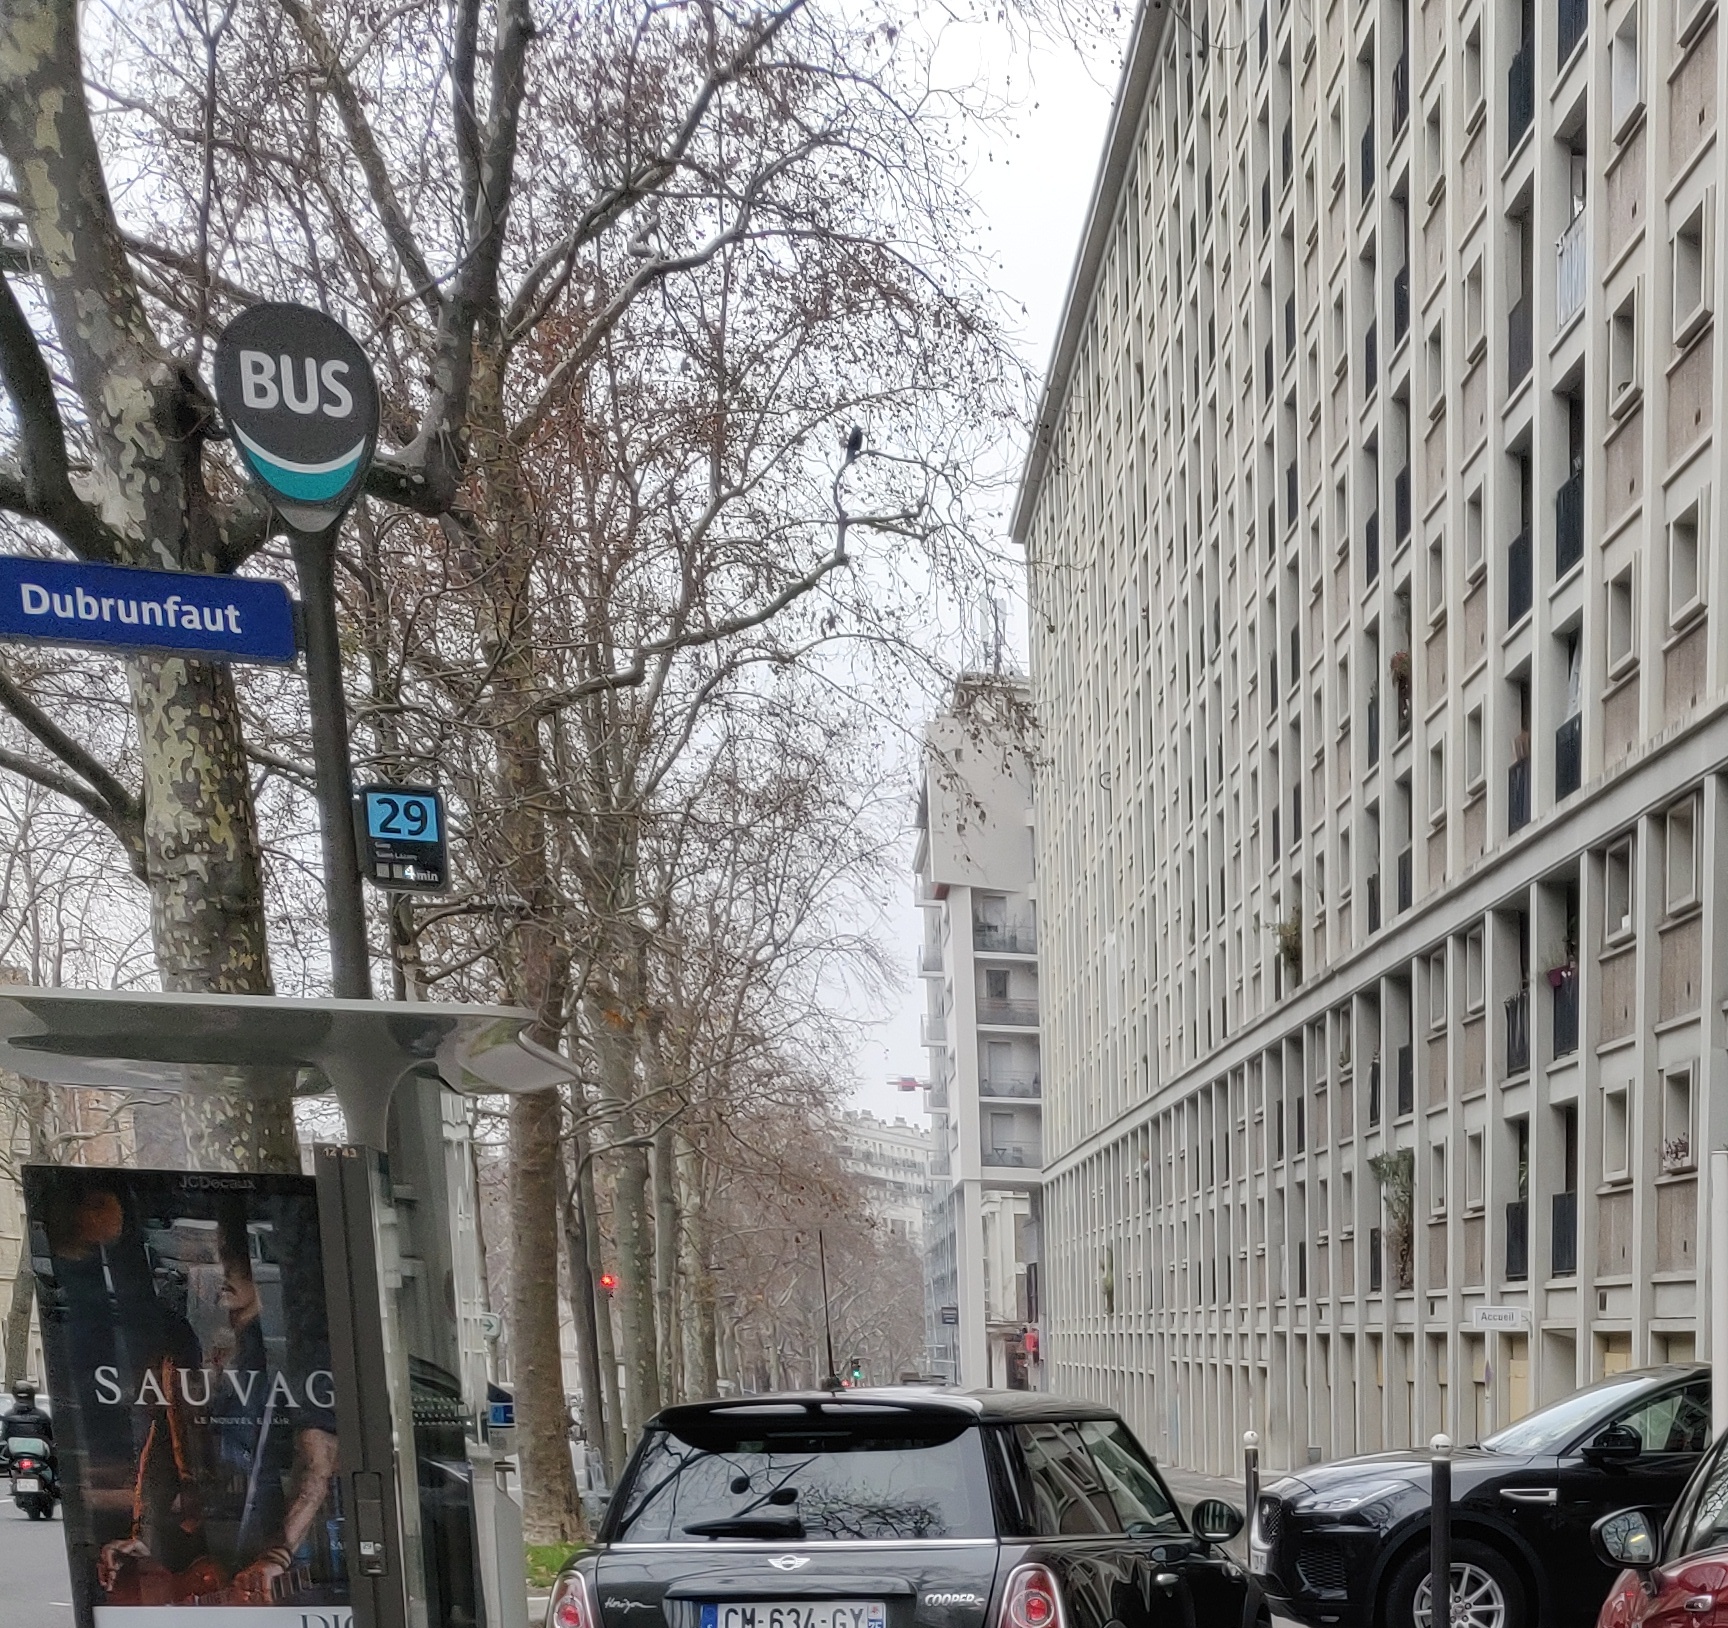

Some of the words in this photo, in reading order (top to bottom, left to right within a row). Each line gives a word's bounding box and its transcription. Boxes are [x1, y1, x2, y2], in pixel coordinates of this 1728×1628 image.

[239, 350, 353, 418] BUS
[21, 583, 242, 634] Dubrunfaut
[376, 798, 428, 836] 29
[404, 865, 416, 880] 4
[416, 870, 439, 881] min
[1481, 1311, 1514, 1321] Accueil
